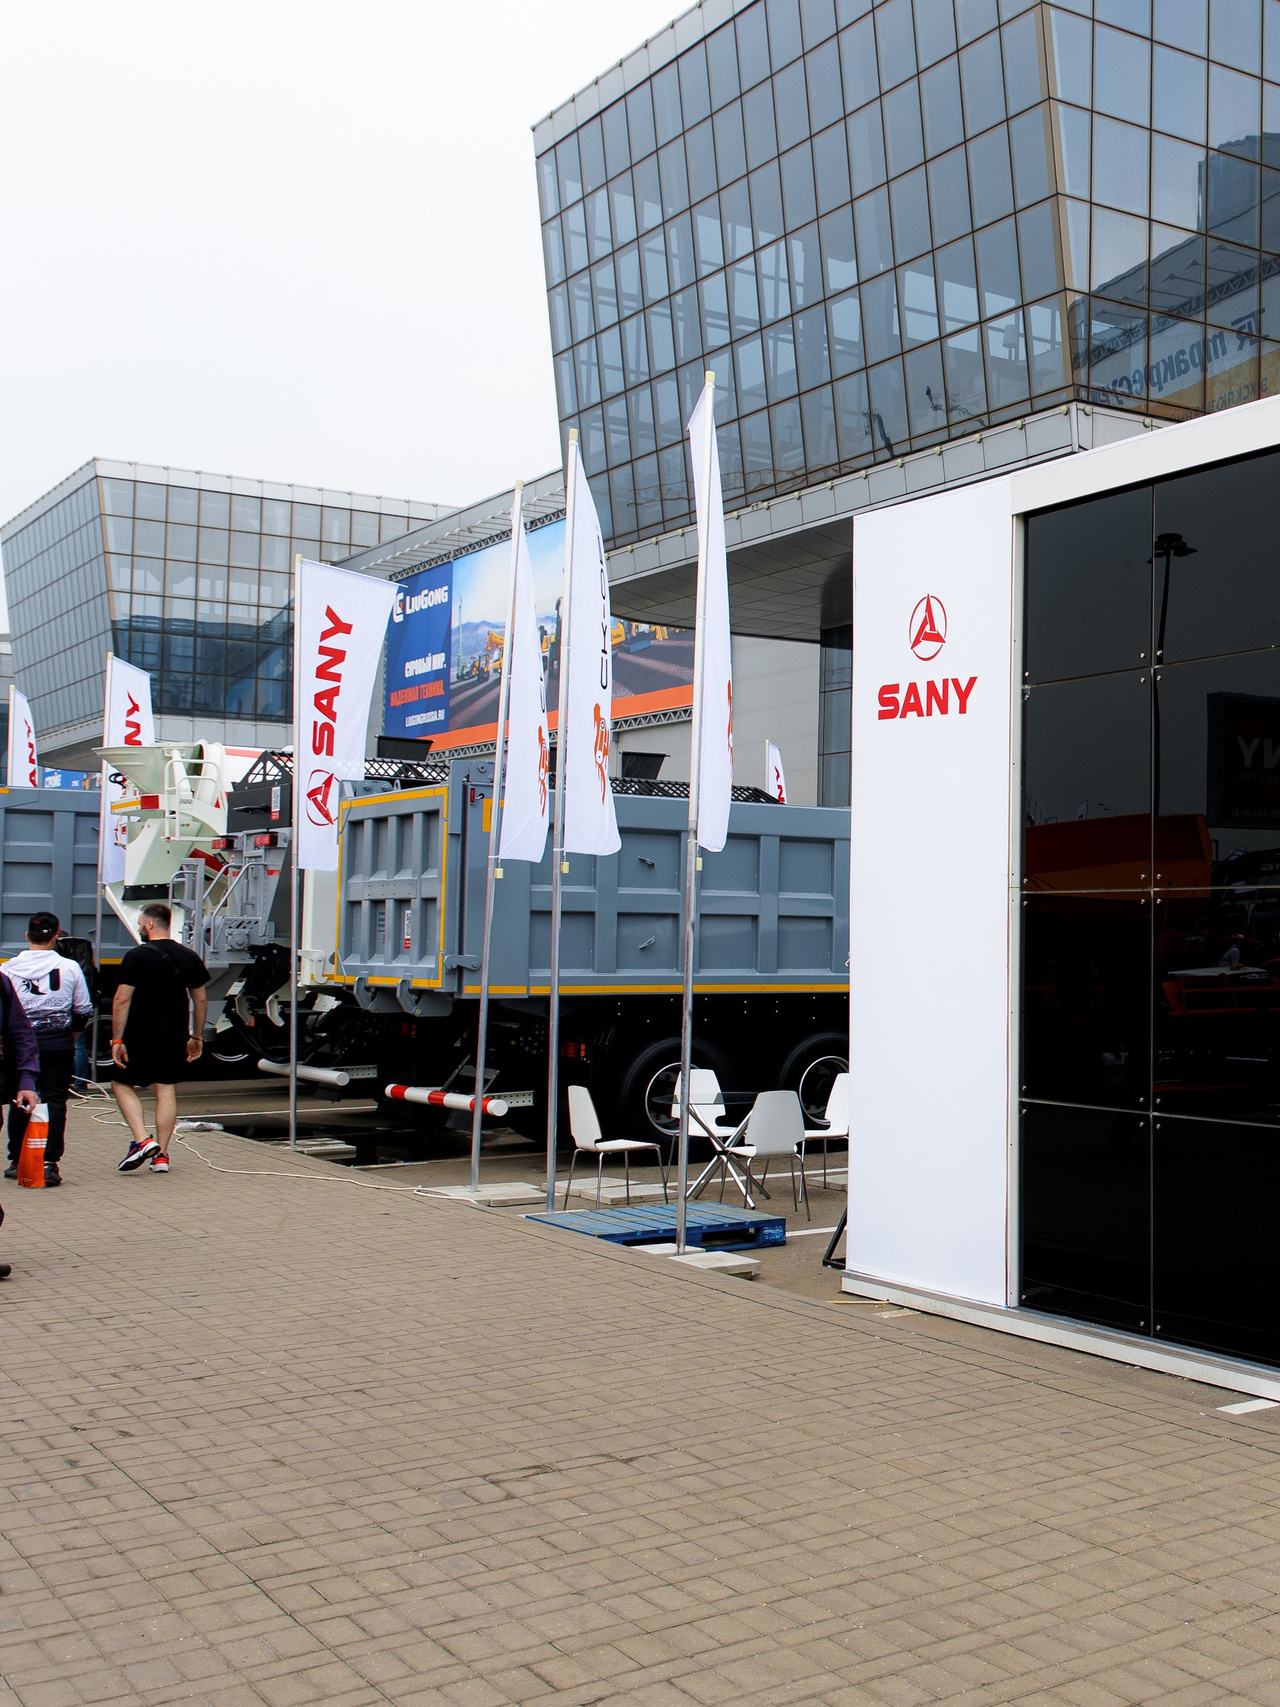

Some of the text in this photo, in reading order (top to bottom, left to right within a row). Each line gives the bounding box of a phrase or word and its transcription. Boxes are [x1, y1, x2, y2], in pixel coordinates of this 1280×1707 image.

[312, 604, 353, 757] SANY
[878, 676, 978, 720] SANY
[124, 691, 142, 746] NY
[24, 718, 38, 787] ANY
